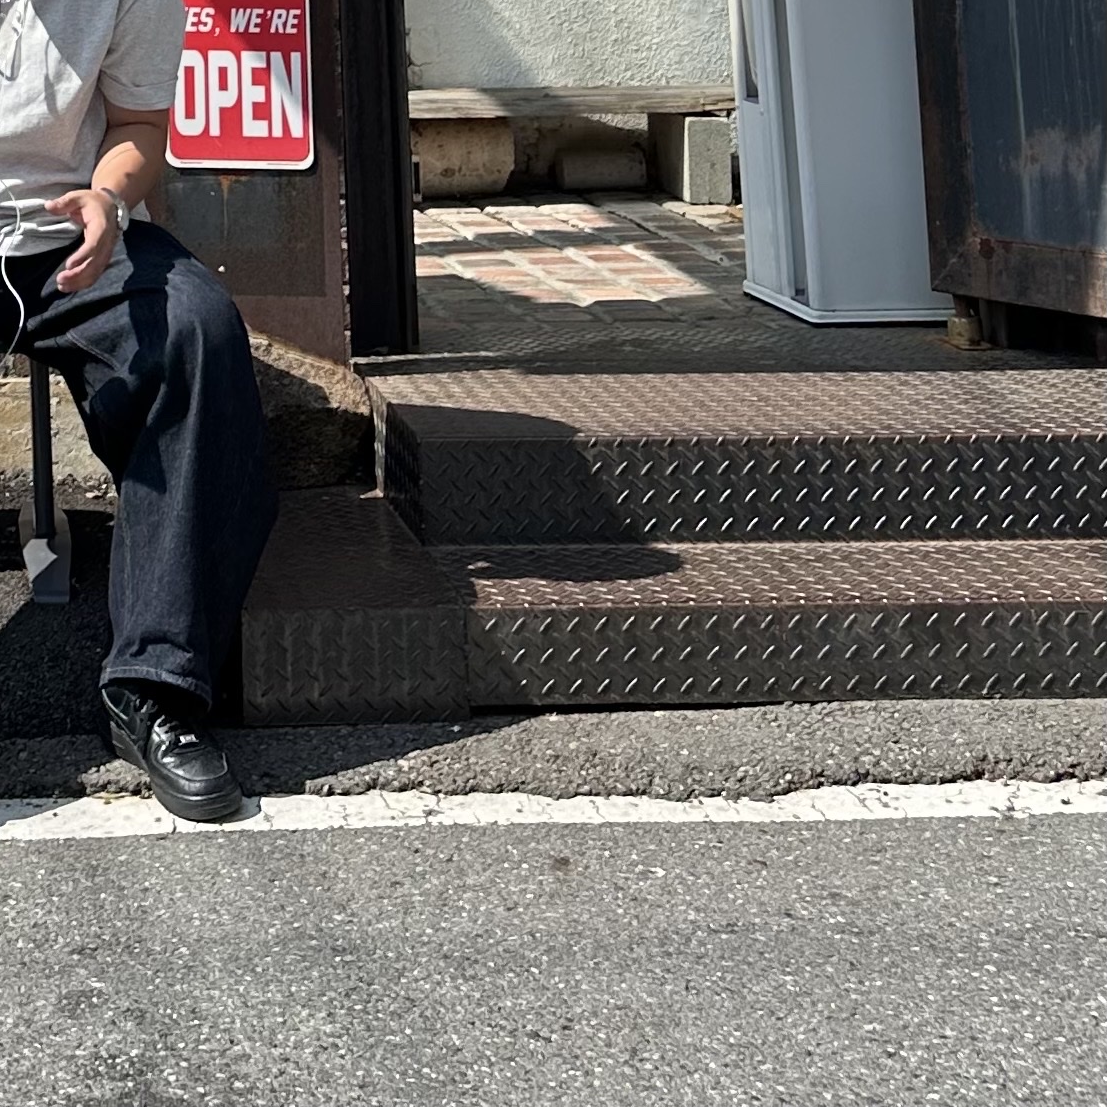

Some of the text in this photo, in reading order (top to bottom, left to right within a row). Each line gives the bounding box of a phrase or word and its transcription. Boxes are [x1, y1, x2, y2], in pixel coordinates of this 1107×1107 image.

[184, 6, 302, 37] ES, WE'RE
[174, 49, 304, 139] OPEN
